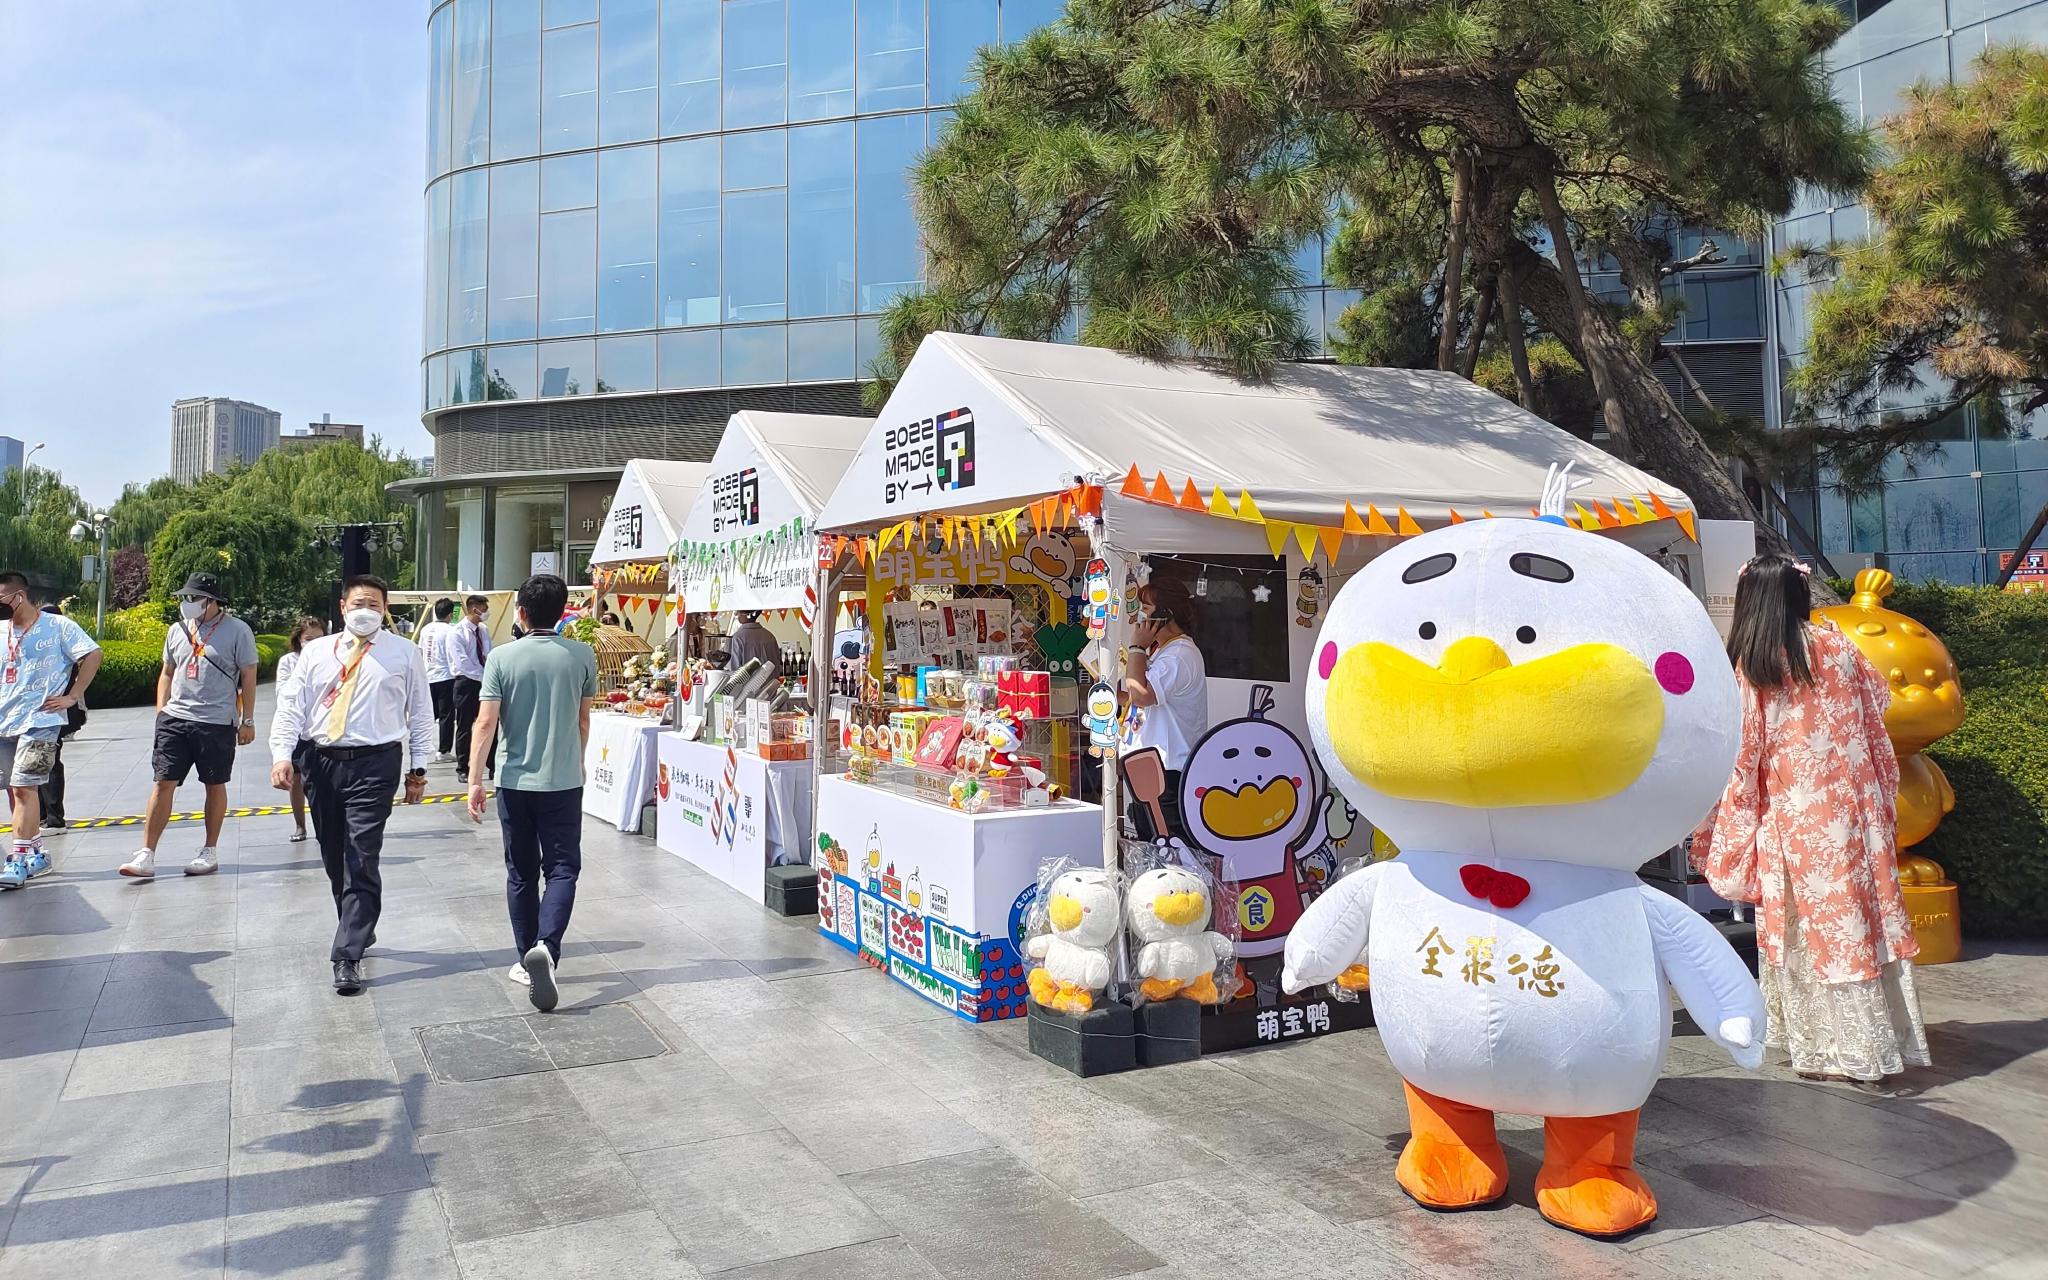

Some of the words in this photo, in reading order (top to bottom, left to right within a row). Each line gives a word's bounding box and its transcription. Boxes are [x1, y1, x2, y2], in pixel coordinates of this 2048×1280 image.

[885, 417, 935, 451] 2022
[885, 445, 935, 478] MADE
[713, 472, 739, 495] 2022
[885, 480, 909, 504] BY
[614, 507, 630, 522] 2022
[713, 492, 739, 515] MADE
[614, 523, 630, 537] MADE
[713, 517, 726, 533] BY
[614, 540, 622, 553] BY
[820, 544, 832, 561] 22
[931, 892, 947, 906] SUPER
[1243, 891, 1268, 926] 食
[1416, 926, 1565, 998] 全聚德
[1256, 1001, 1331, 1041] 萌宝鸭
